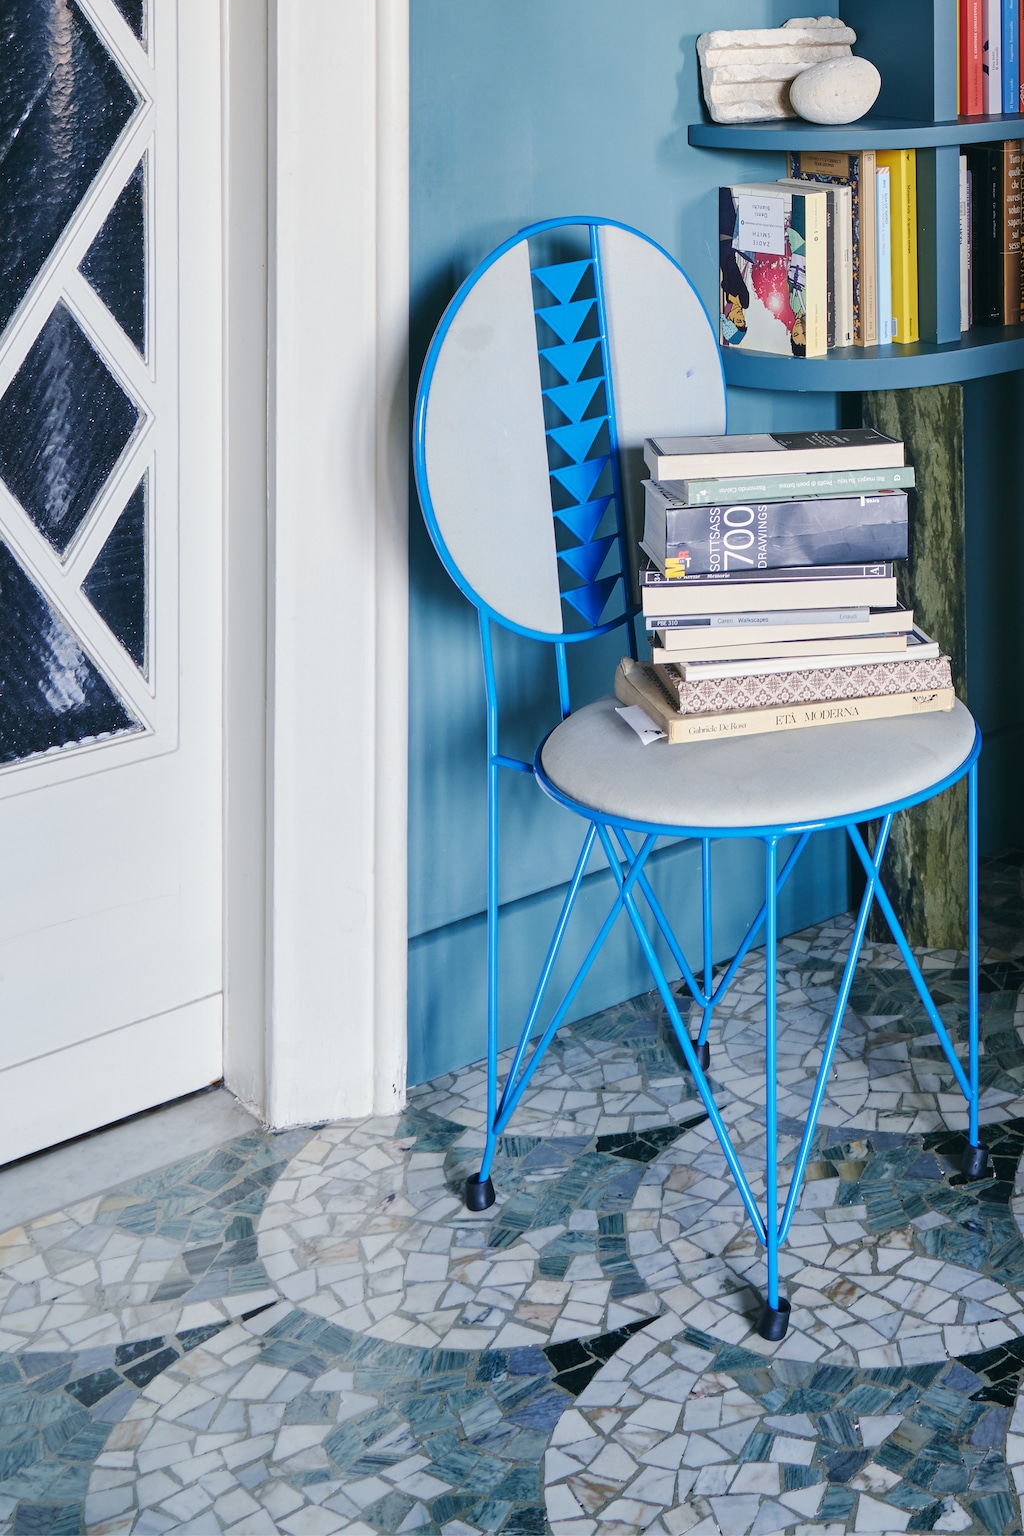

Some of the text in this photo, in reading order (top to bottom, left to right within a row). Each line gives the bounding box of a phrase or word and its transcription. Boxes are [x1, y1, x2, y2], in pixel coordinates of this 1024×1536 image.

[709, 507, 720, 572] SOTTSASS
[723, 506, 755, 571] 700
[758, 505, 768, 568] DRAWINGS
[688, 722, 747, 735] Gabriele De Rosa
[775, 707, 860, 726] ETÀ MODERNA
